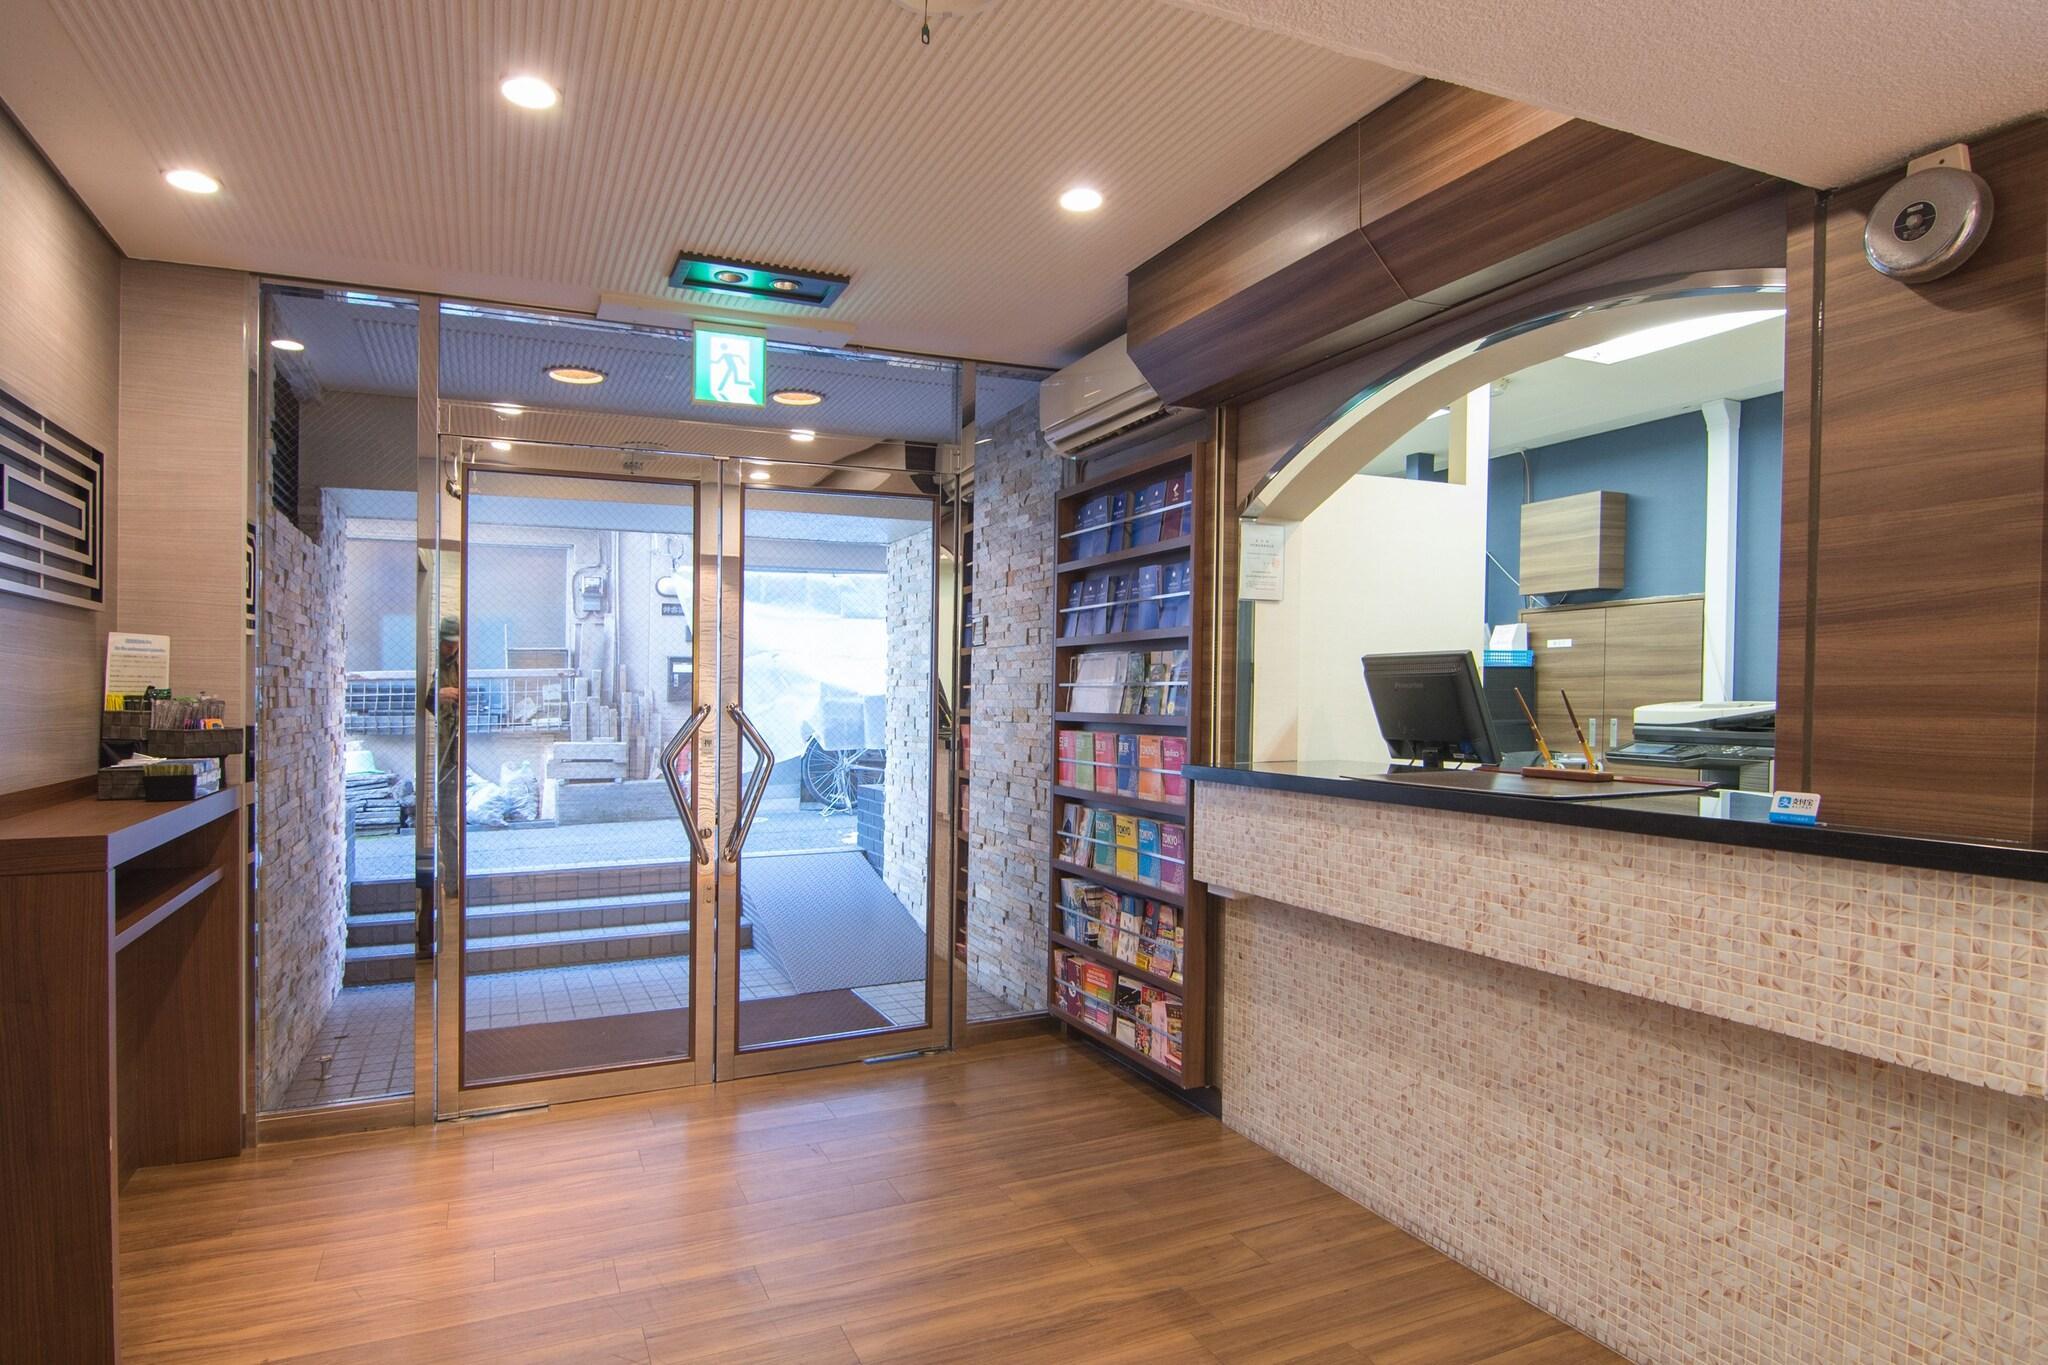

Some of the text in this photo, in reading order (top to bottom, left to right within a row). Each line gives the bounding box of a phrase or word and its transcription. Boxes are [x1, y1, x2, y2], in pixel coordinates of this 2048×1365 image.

[1792, 797, 1814, 806] 支付宝
[1162, 833, 1178, 847] TOKYO
